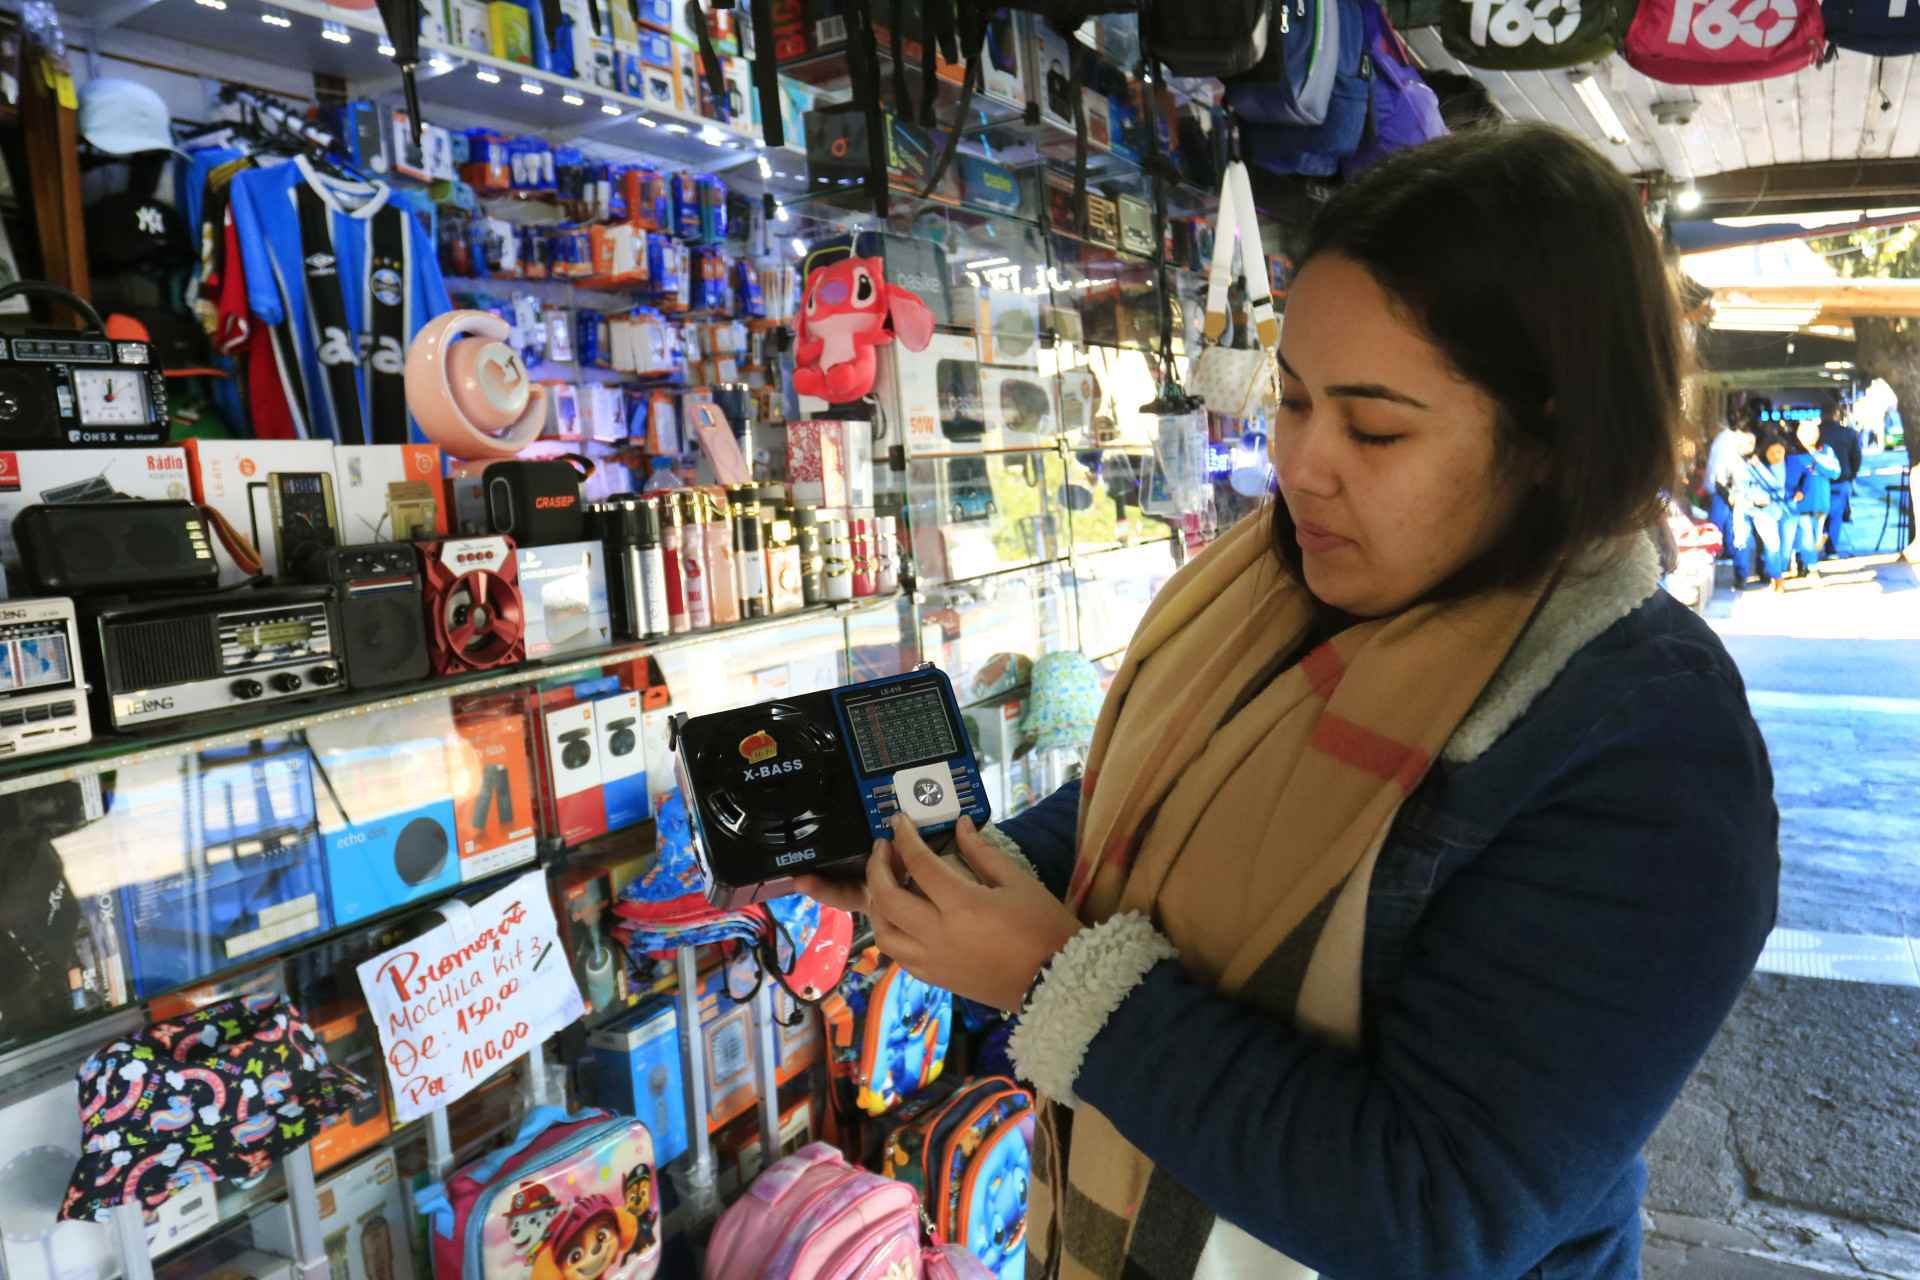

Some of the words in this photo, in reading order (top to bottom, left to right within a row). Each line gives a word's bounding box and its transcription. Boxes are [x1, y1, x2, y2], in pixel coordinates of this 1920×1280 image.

[743, 758, 804, 782] X-BASS
[337, 832, 366, 849] echo
[462, 1021, 529, 1079] 100,00
